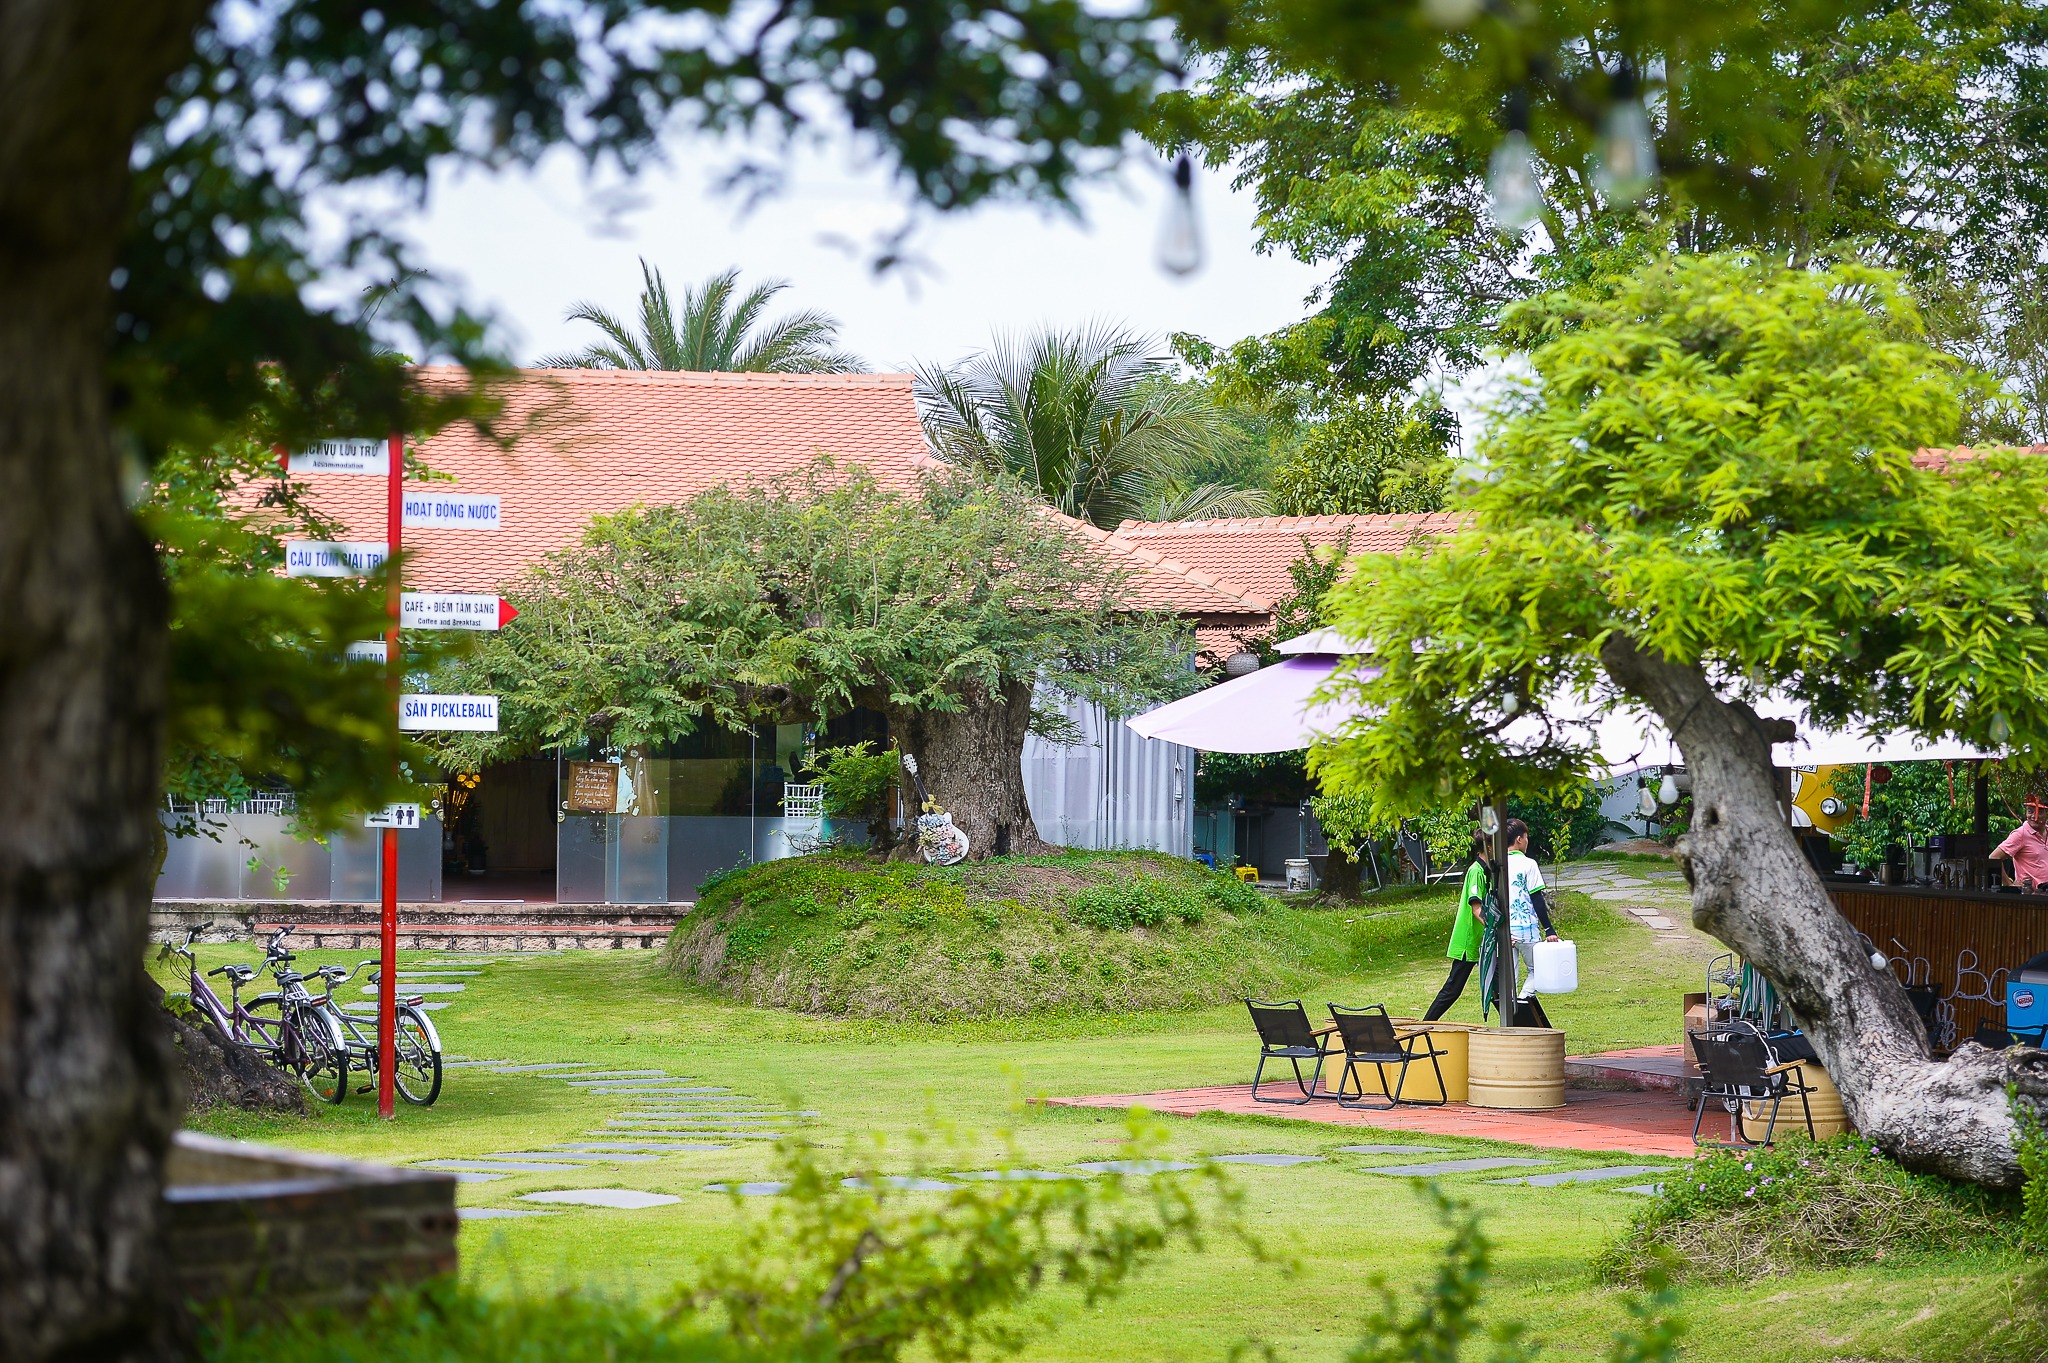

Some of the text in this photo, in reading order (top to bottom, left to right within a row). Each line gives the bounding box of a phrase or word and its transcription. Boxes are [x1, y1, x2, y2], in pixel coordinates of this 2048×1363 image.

[323, 443, 336, 458] VỤ
[359, 443, 379, 457] TRÚ
[313, 460, 364, 469] Accommodation
[405, 500, 497, 521] HOẠT ĐỘNG NƯỚC
[405, 598, 424, 612] CAFÉ
[434, 597, 453, 613] ĐIỂM
[474, 601, 494, 614] SÁNG
[418, 617, 482, 627] Coffee and Breakfast
[405, 698, 493, 718] SÂN PICKLEBALL
